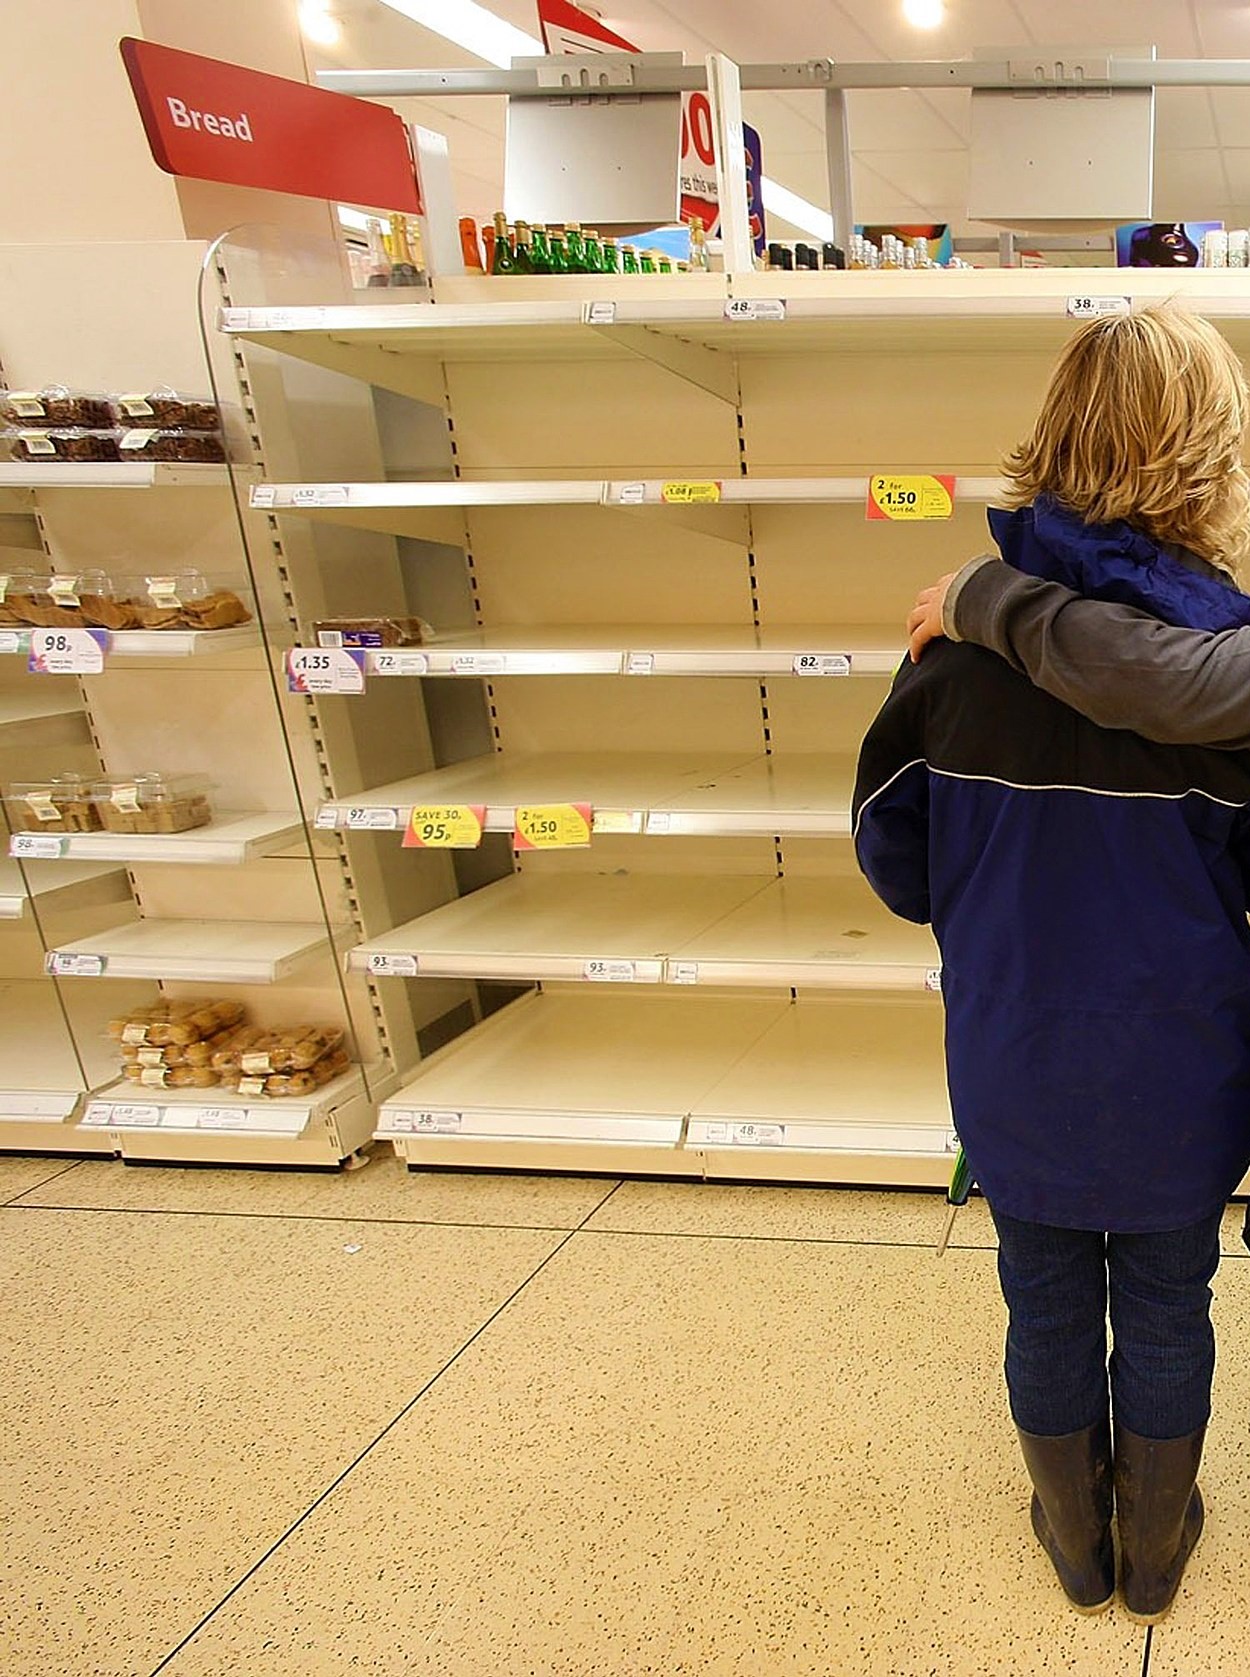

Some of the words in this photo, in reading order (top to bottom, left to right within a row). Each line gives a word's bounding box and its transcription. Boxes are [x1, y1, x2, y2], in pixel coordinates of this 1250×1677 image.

[167, 95, 255, 142] Bread
[878, 480, 885, 489] 2
[889, 482, 903, 490] for
[880, 492, 917, 504] £1.50
[45, 636, 73, 652] 98p
[296, 656, 331, 670] £1.35
[415, 811, 440, 820] SAVE
[522, 811, 529, 821] 2
[423, 824, 452, 841] 95p
[524, 821, 557, 834] £1.50
